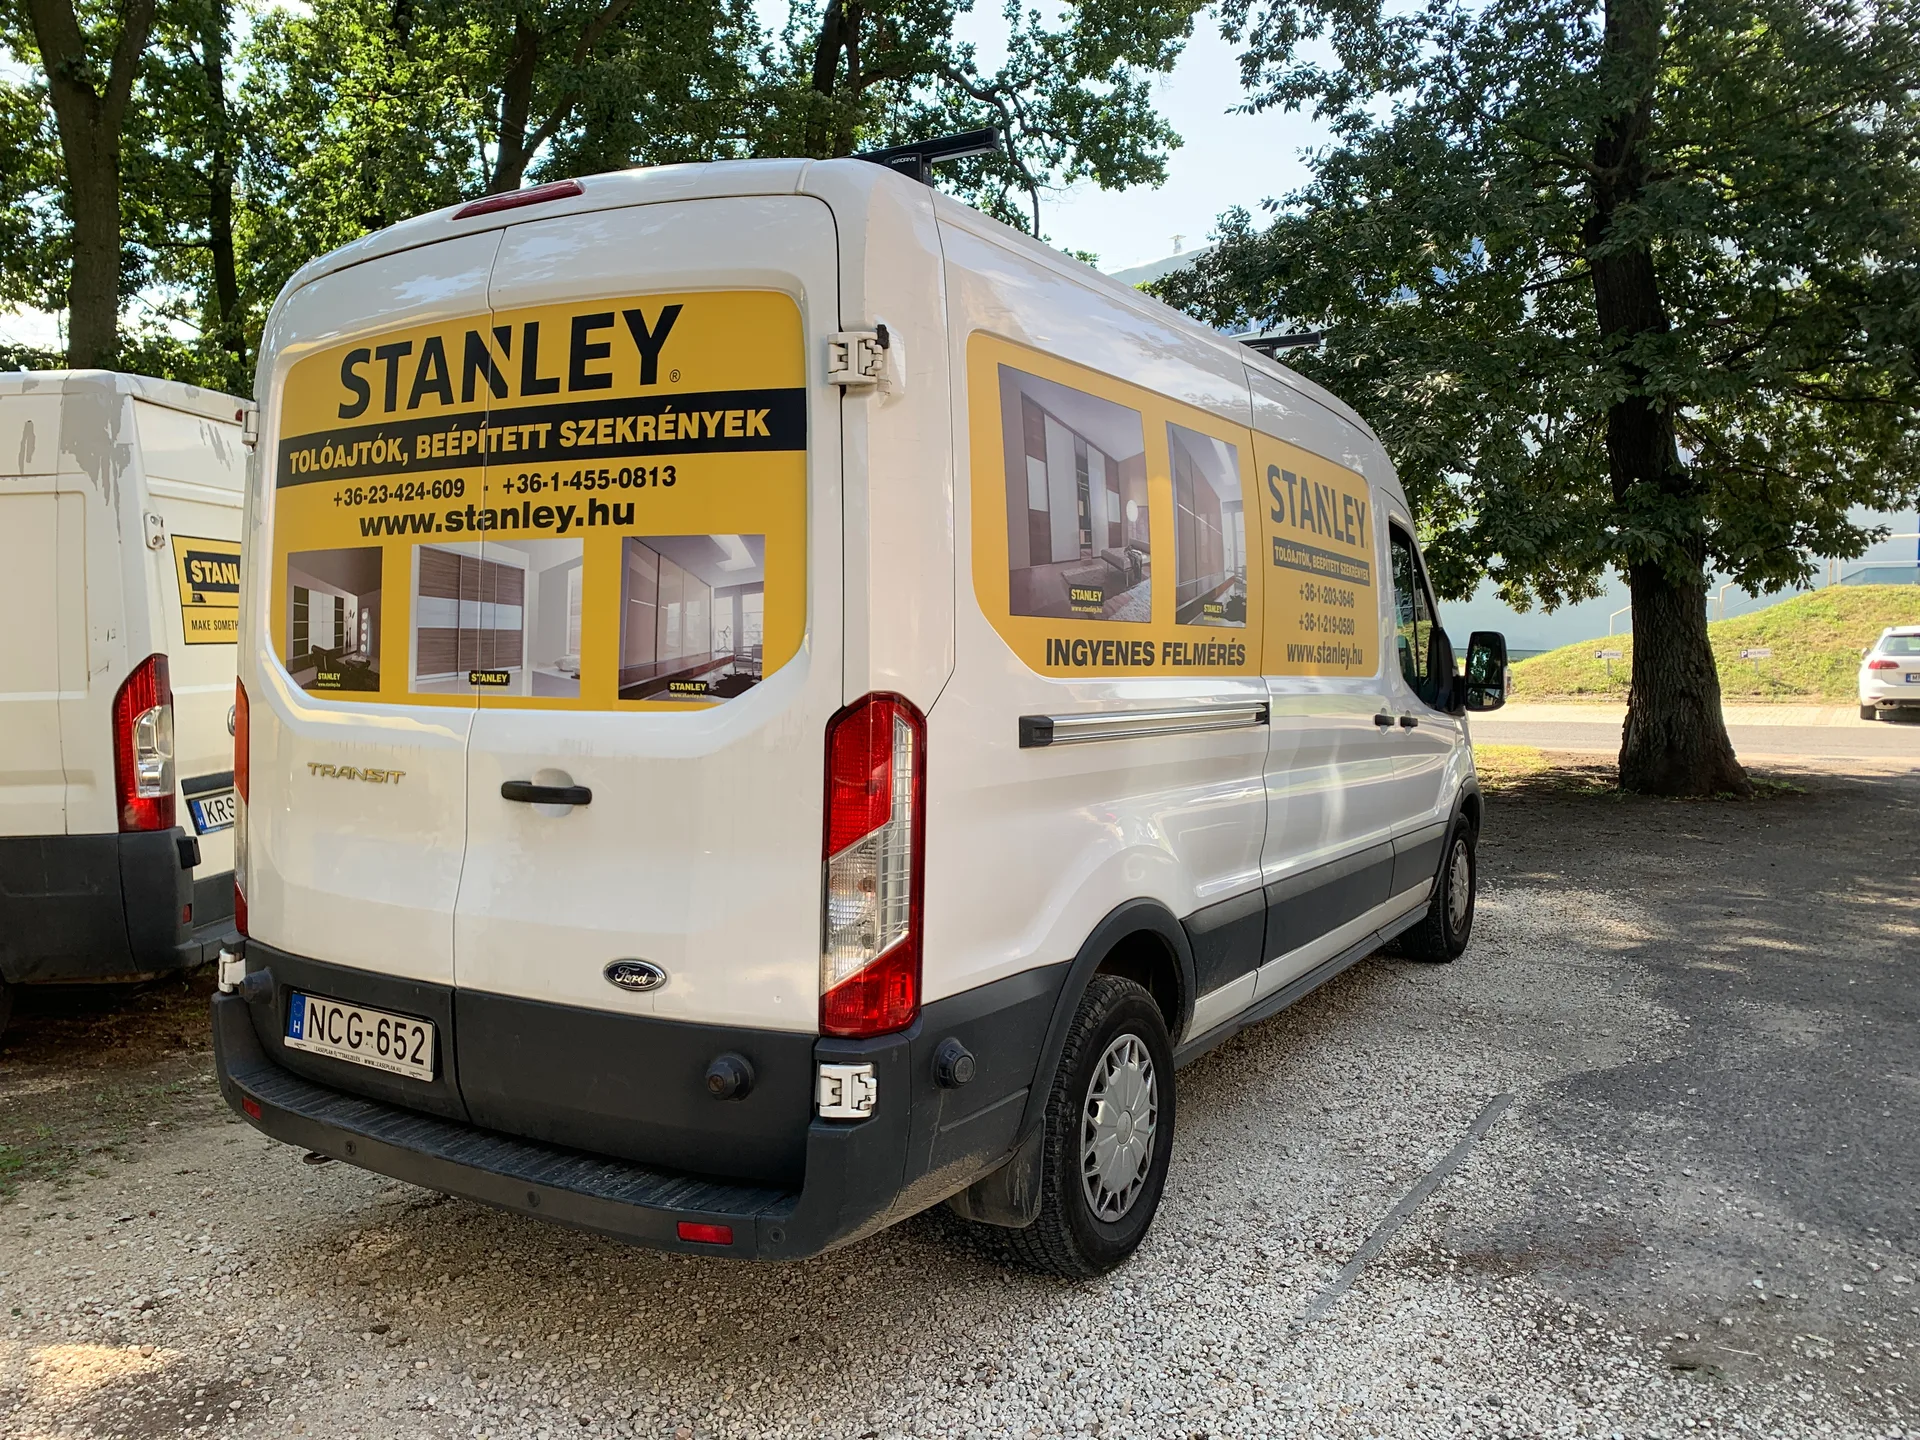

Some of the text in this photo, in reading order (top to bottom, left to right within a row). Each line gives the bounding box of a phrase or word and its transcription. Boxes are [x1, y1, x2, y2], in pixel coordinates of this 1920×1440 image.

[338, 304, 684, 419] STANLEY
[289, 405, 771, 475] TOLÓAJTÓK, BEÉPÍTETT SZEKRÉNYEK
[333, 465, 677, 508] +36-23-424-609 +36-1-455-0813
[359, 498, 635, 537] www.stanley.hu
[1267, 464, 1366, 548] STANLEY
[1071, 588, 1103, 602] STANLEY
[191, 619, 211, 631] MAKE
[1046, 636, 1246, 667] INGYENES FELMÉRÉS
[1286, 641, 1363, 670] www.stanley.hu
[317, 672, 341, 681] STANLEY
[471, 673, 508, 683] STANLEY
[670, 682, 707, 691] STANLEY
[307, 762, 407, 785] TRANSIT
[614, 965, 649, 985] Ford
[293, 1002, 426, 1066] H NCG-652
